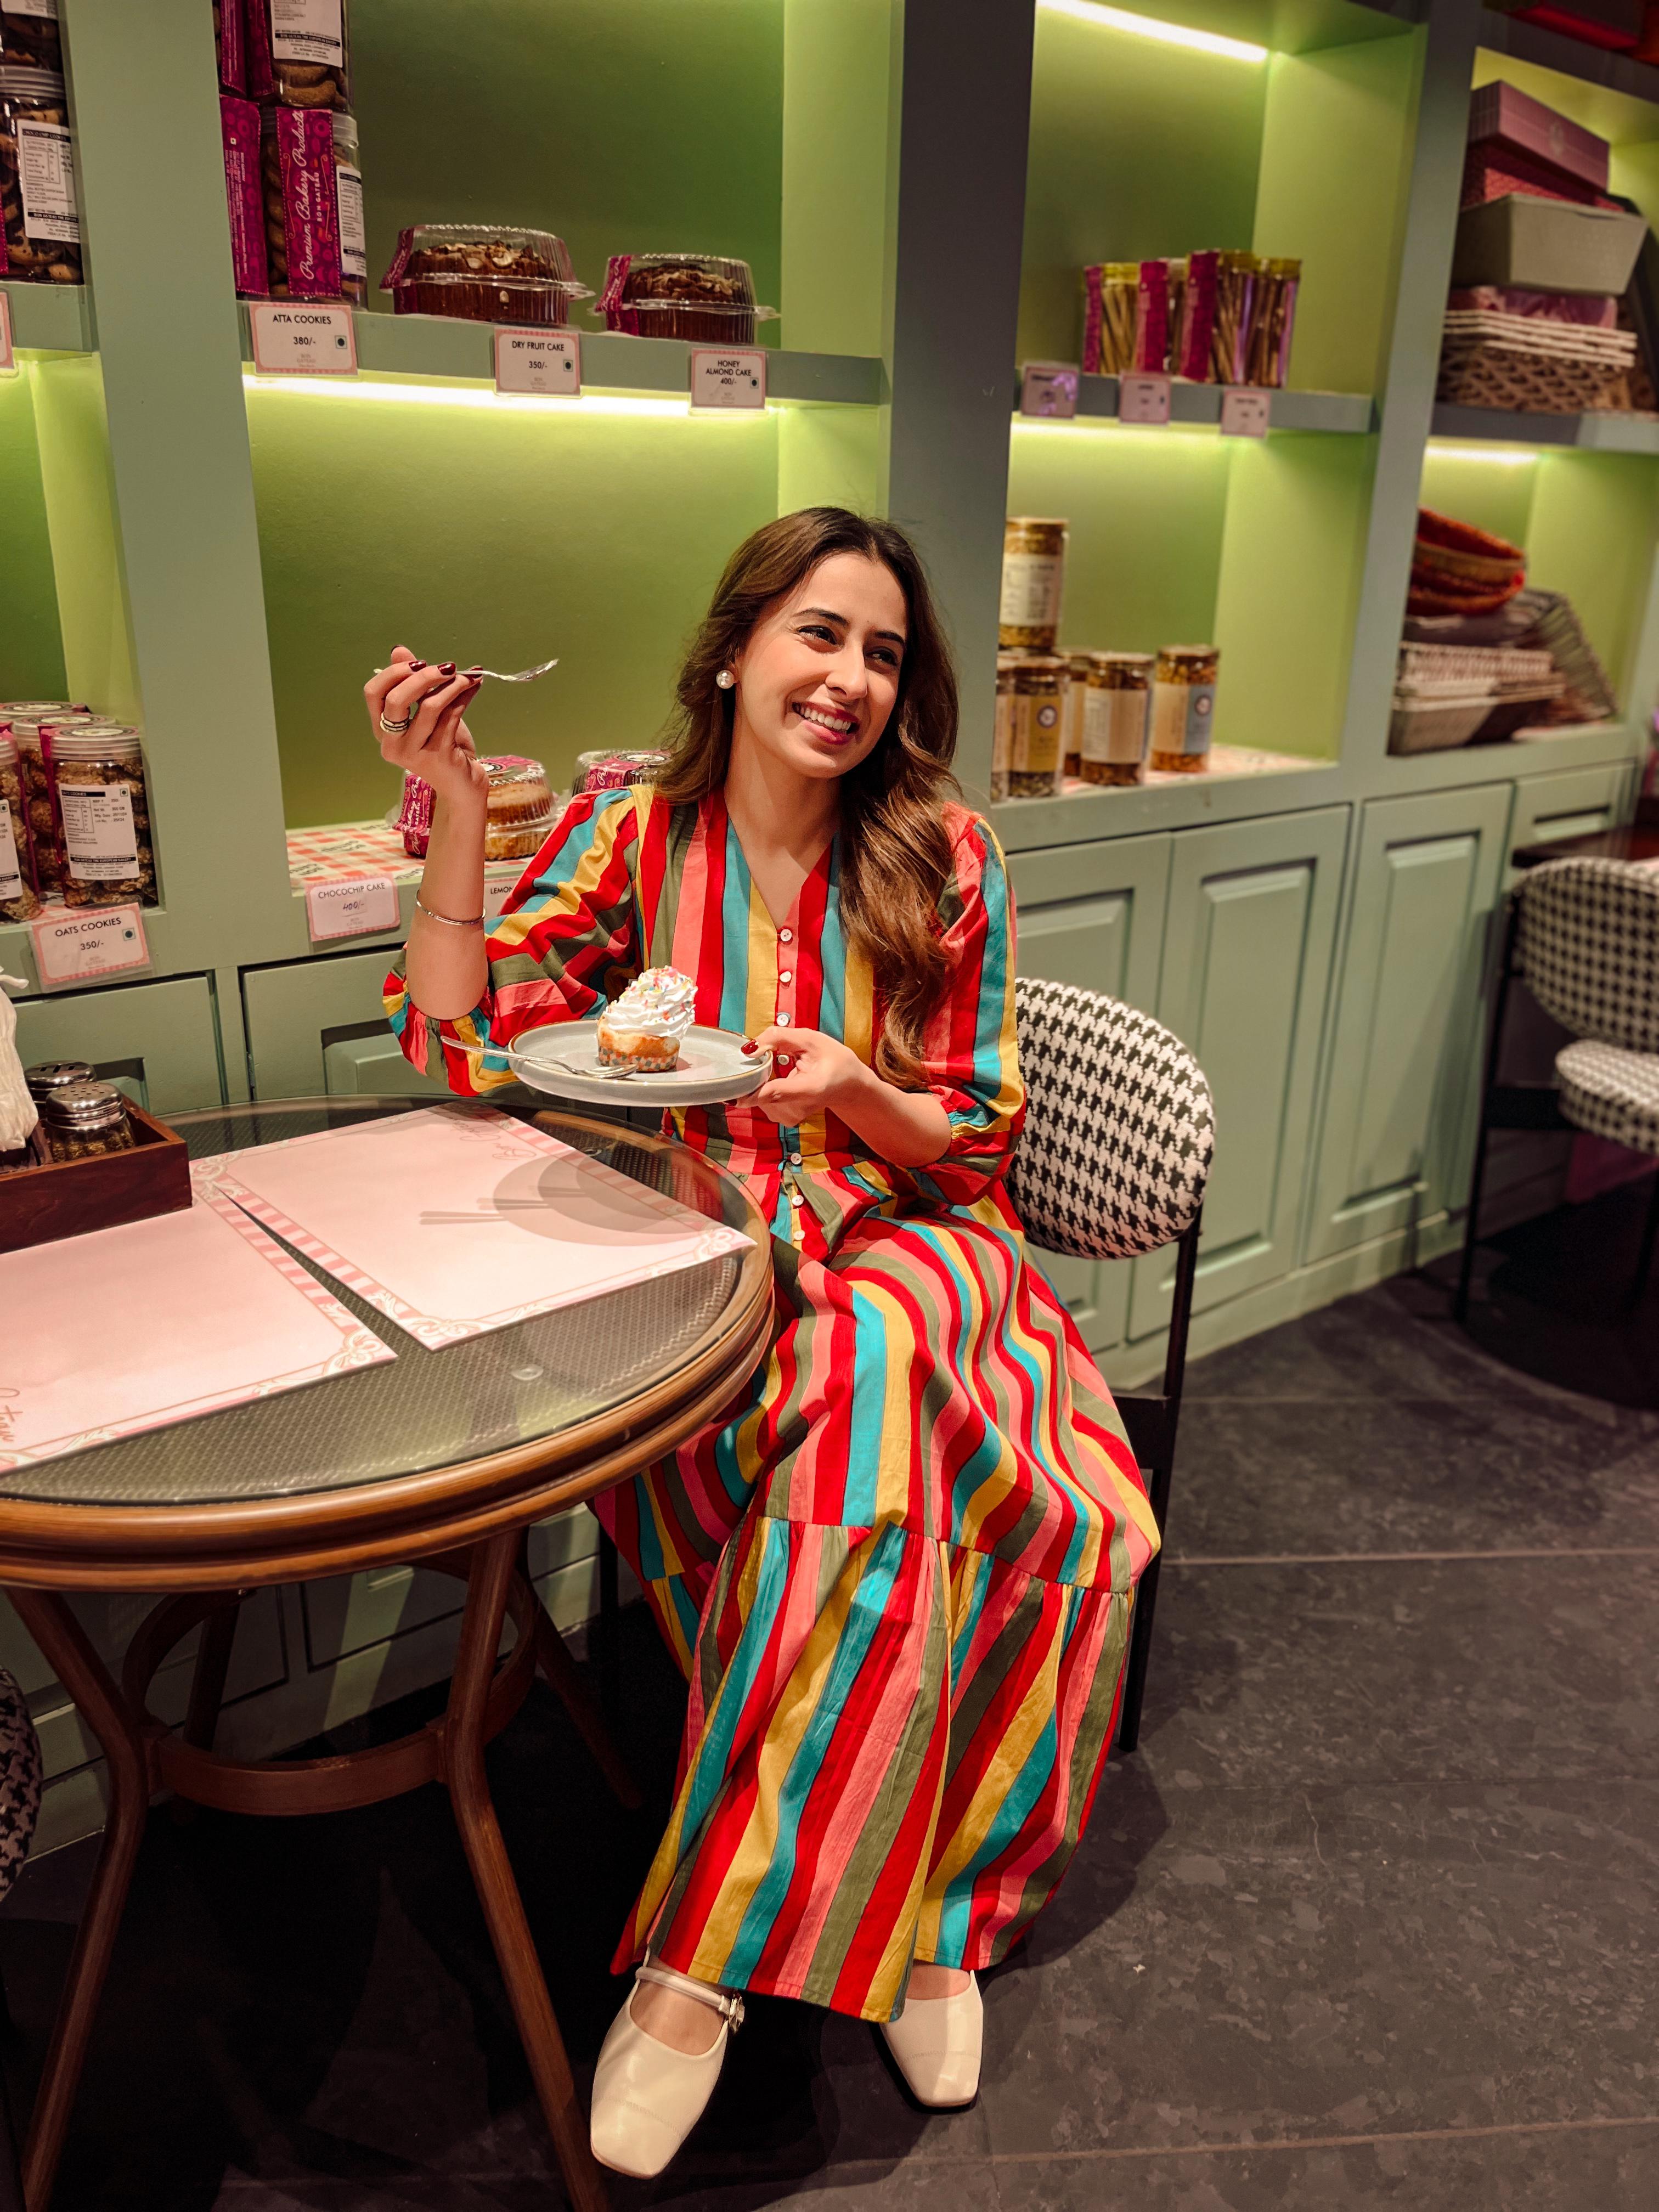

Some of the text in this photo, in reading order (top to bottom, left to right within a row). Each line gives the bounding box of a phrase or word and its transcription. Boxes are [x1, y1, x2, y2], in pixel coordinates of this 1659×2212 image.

[292, 110, 314, 280] Premium Bakery Products
[273, 314, 331, 325] ATTA COOKIES
[293, 336, 316, 346] 380/-
[512, 341, 564, 352] DRY FRUIT CAKE
[529, 361, 548, 369] 350/-
[318, 882, 386, 899] CHOCOCHIP CAKE
[343, 901, 365, 911] 400/-
[55, 917, 121, 937] OATS COOKIES
[80, 940, 104, 950] 350/-
